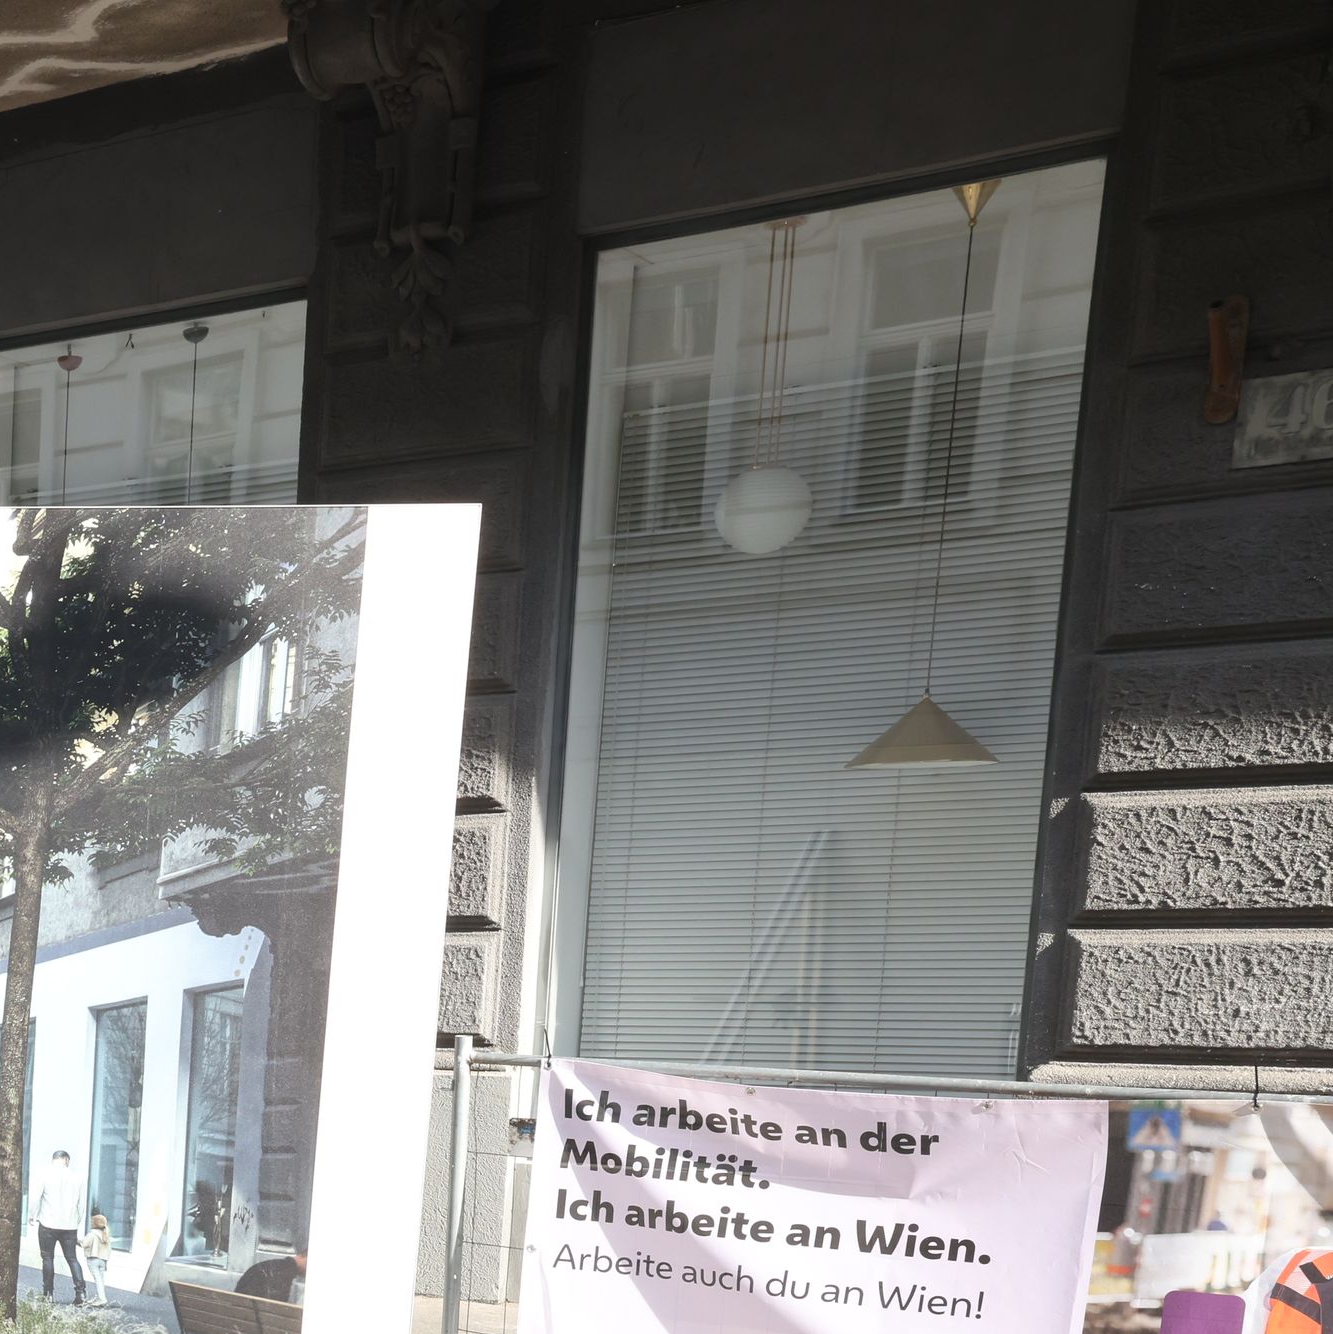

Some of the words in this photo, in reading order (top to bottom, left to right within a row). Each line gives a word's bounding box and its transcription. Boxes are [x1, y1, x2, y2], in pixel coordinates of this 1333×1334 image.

[563, 1087, 622, 1124] Ich
[632, 1099, 783, 1142] arbeite
[794, 1122, 848, 1150] an
[860, 1122, 940, 1156] der
[559, 1138, 771, 1190] Mobilität.
[555, 1189, 614, 1224] Ich
[624, 1200, 774, 1243] arbeite
[786, 1221, 841, 1250] an
[855, 1219, 992, 1265] Wien.
[552, 1243, 673, 1281] Arbeite
[681, 1259, 755, 1295] auch
[765, 1269, 811, 1300] du
[820, 1282, 865, 1307] an
[877, 1281, 985, 1320] Wien!
